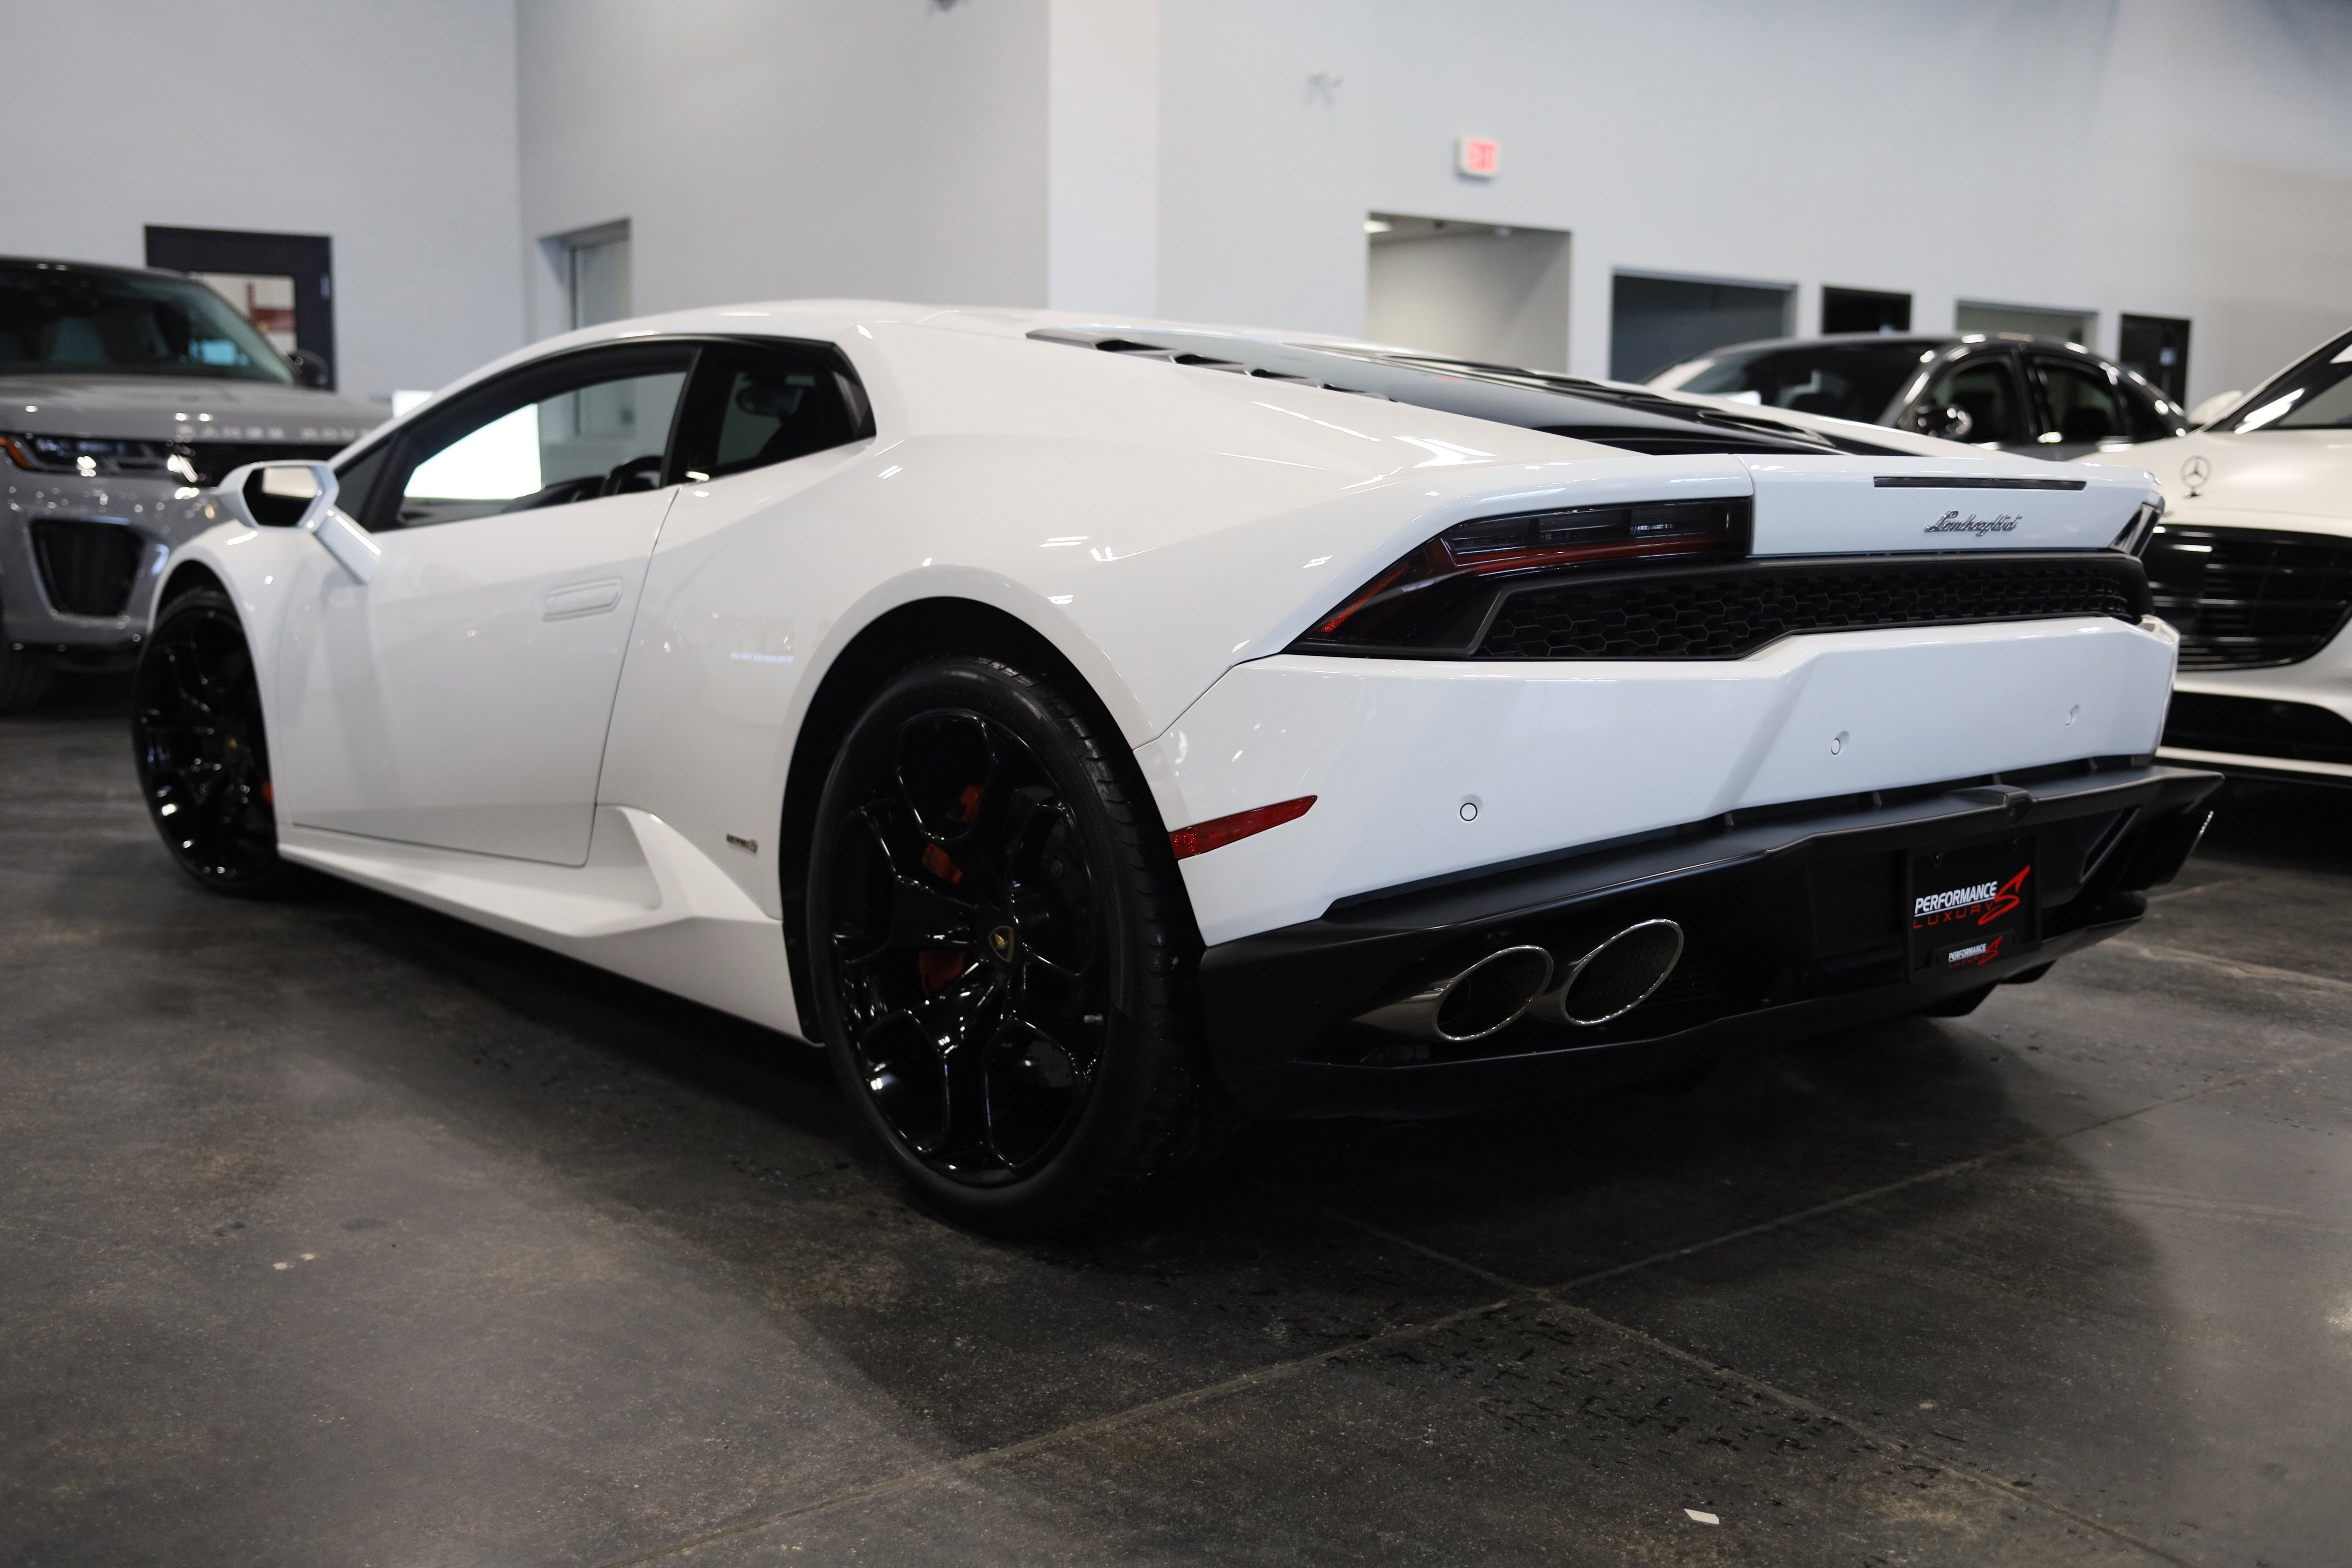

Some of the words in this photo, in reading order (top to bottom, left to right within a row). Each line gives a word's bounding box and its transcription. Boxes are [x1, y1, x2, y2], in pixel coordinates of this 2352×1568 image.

[1914, 880, 1998, 914] PERFORMANCE
[1913, 901, 1993, 929] LUXURY
[1948, 943, 1987, 961] PERFORMANCE
